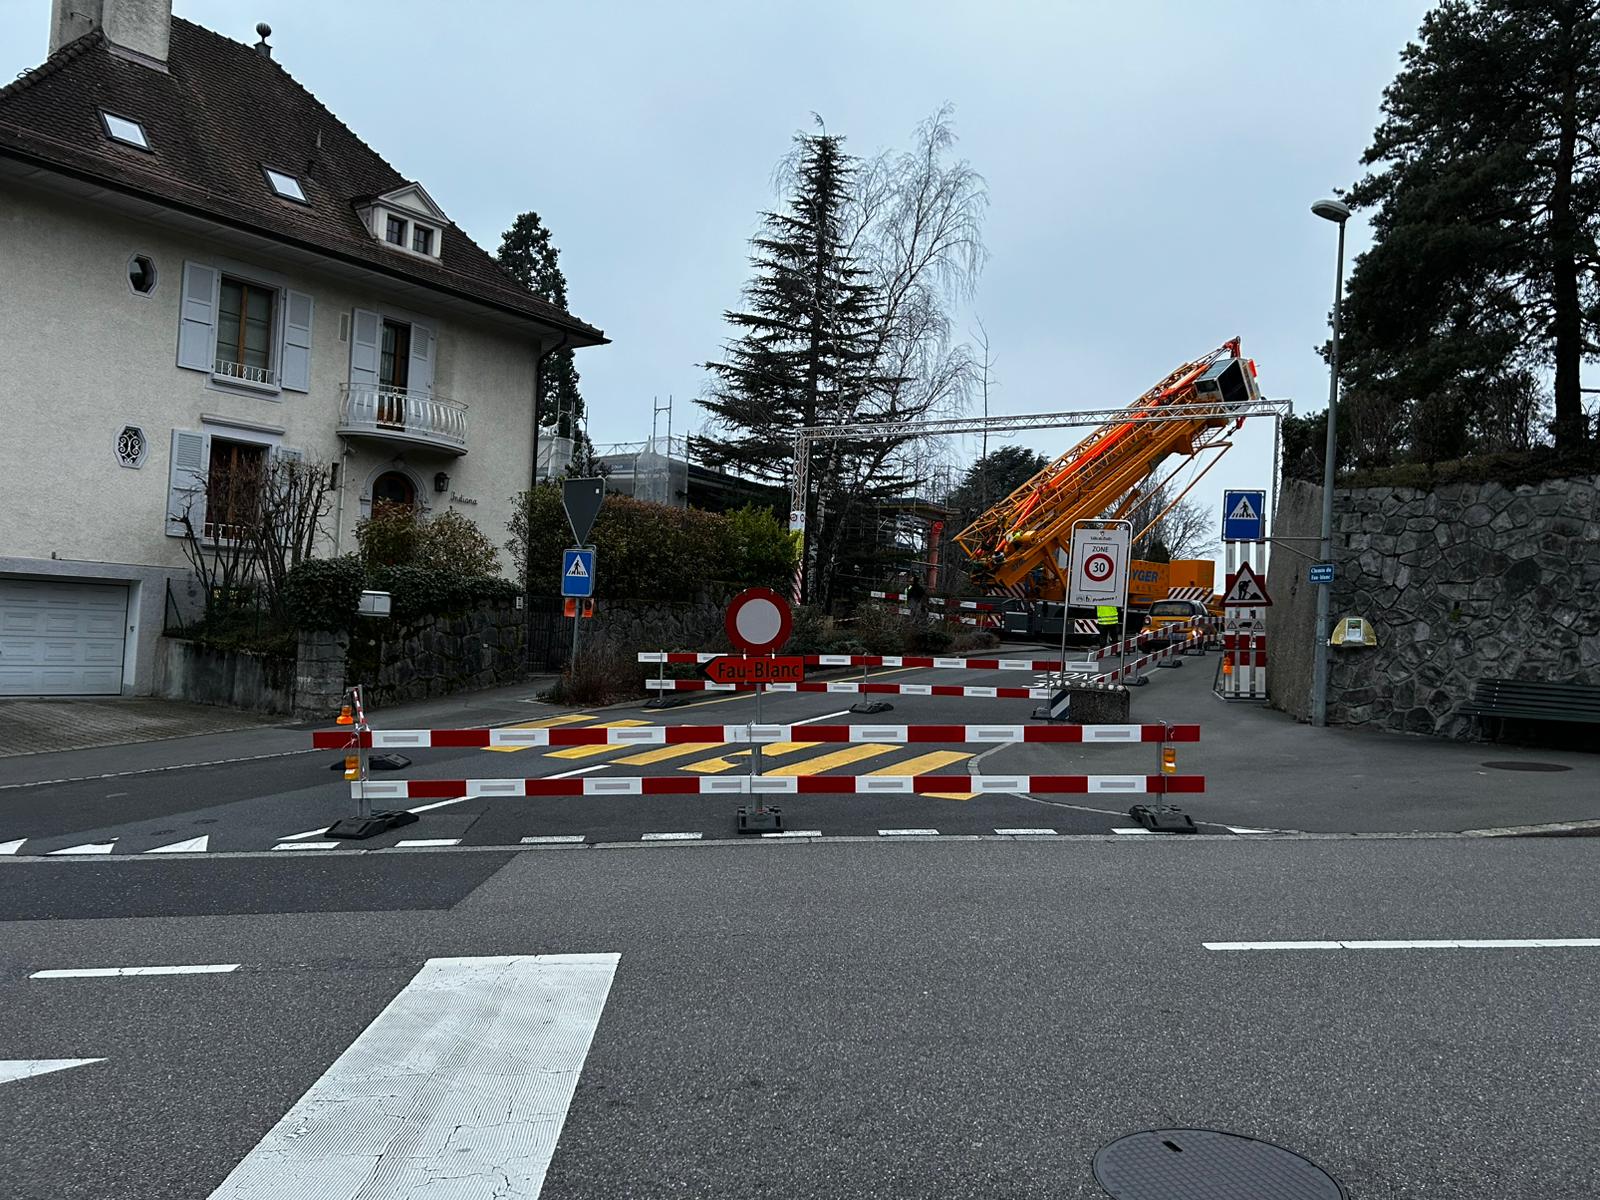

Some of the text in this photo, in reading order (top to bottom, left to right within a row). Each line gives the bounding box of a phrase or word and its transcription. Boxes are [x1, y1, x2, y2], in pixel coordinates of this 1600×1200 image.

[450, 491, 478, 505] Indiana
[1093, 562, 1106, 573] 30
[719, 662, 800, 679] Fau-Blanc
